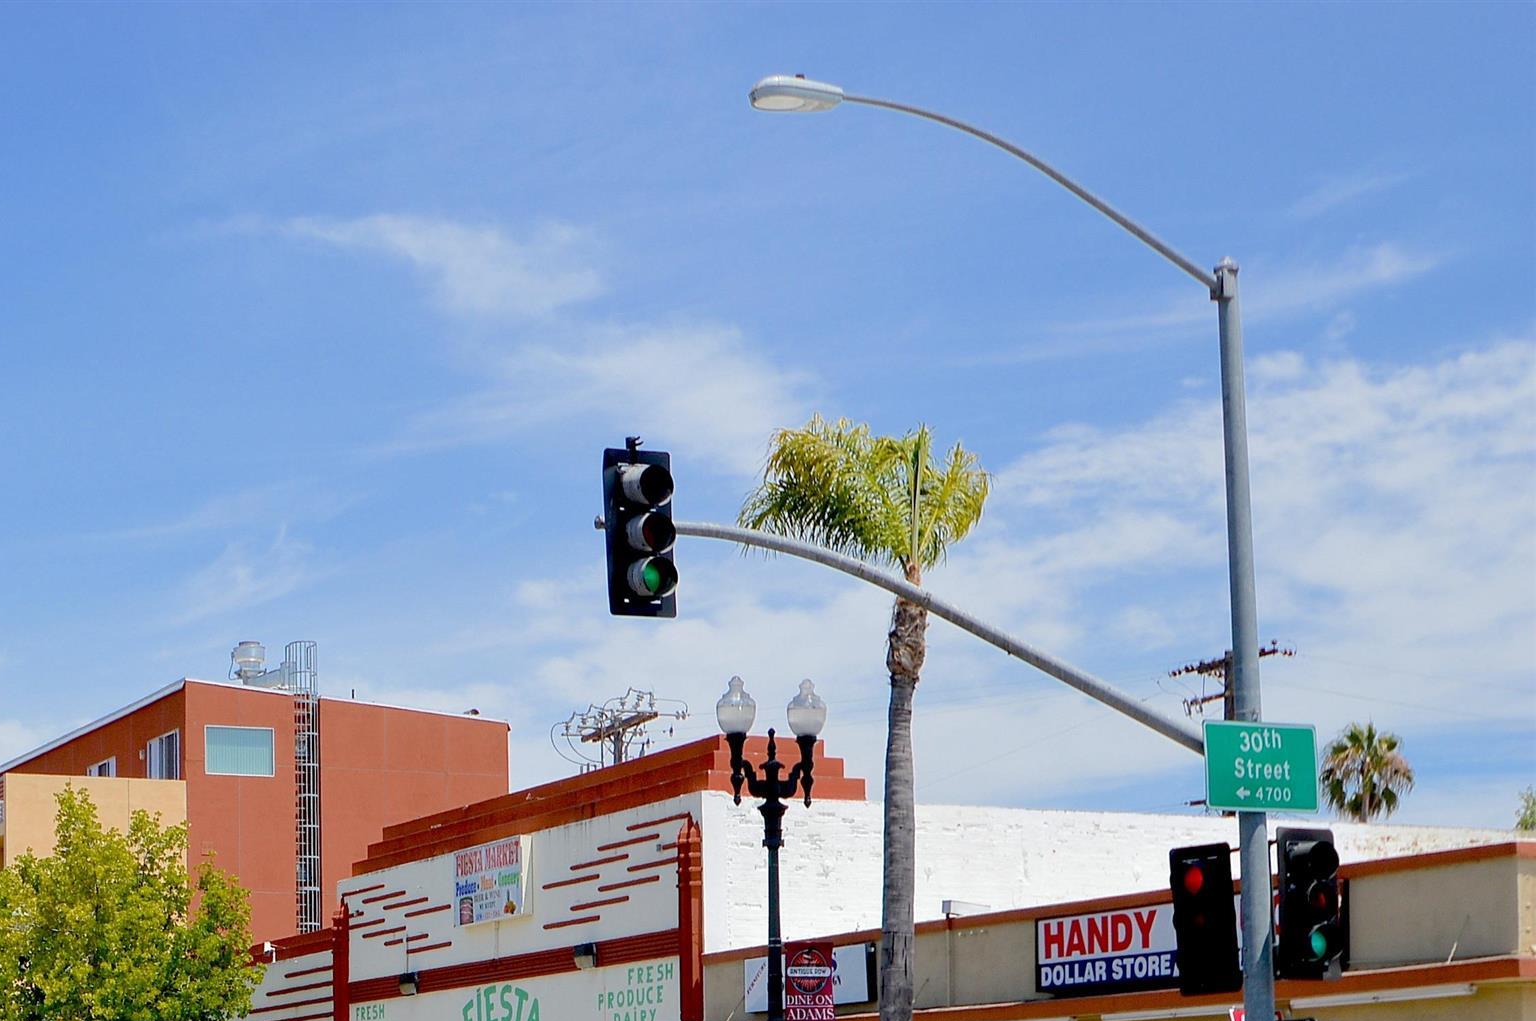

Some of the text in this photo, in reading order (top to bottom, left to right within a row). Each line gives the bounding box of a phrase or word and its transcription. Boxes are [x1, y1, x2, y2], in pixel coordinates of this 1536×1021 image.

[1240, 728, 1282, 752] 30th
[1234, 757, 1291, 780] Street
[1256, 787, 1292, 801] 4700
[456, 840, 521, 877] FIESTA MARKET
[1043, 909, 1158, 960] HANDY
[627, 962, 674, 986] FRESH
[1040, 953, 1172, 988] DOLLAR STORE
[598, 985, 665, 1011] PRODUCE
[786, 994, 834, 1006] DINE ON
[355, 1003, 386, 1021] FRESH
[786, 1008, 836, 1021] ADAMS
